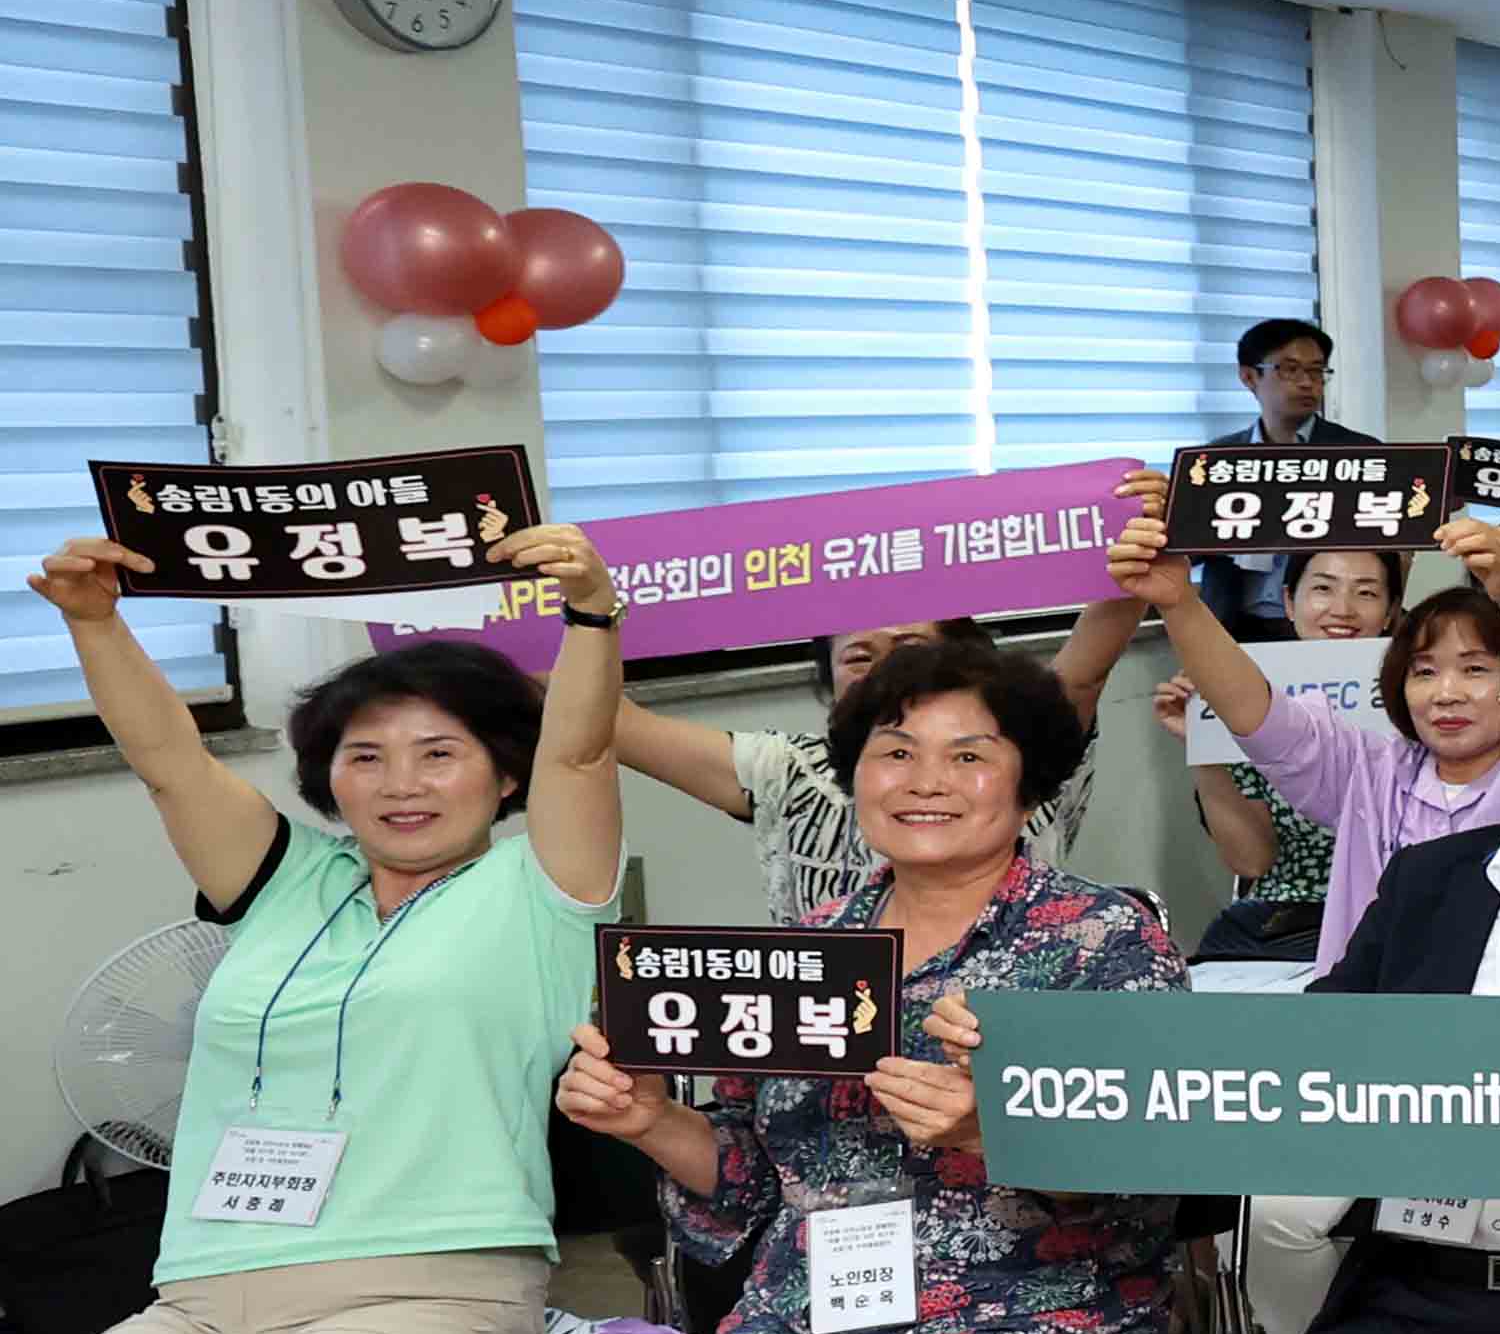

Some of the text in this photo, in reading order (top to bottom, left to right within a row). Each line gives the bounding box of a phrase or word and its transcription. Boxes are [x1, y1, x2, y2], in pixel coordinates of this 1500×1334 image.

[1208, 456, 1387, 484] 송림1동의 아들
[156, 474, 429, 513] 송림1동의 아들
[488, 578, 562, 622] APE
[745, 545, 812, 592] 인천
[823, 529, 923, 577] 유치를
[933, 505, 1115, 566] 기원합니다.
[634, 947, 825, 982] 송림1동의 아들
[1001, 1066, 1129, 1122] 2025
[1145, 1071, 1282, 1122] APEC
[831, 1267, 893, 1287] 노인회장
